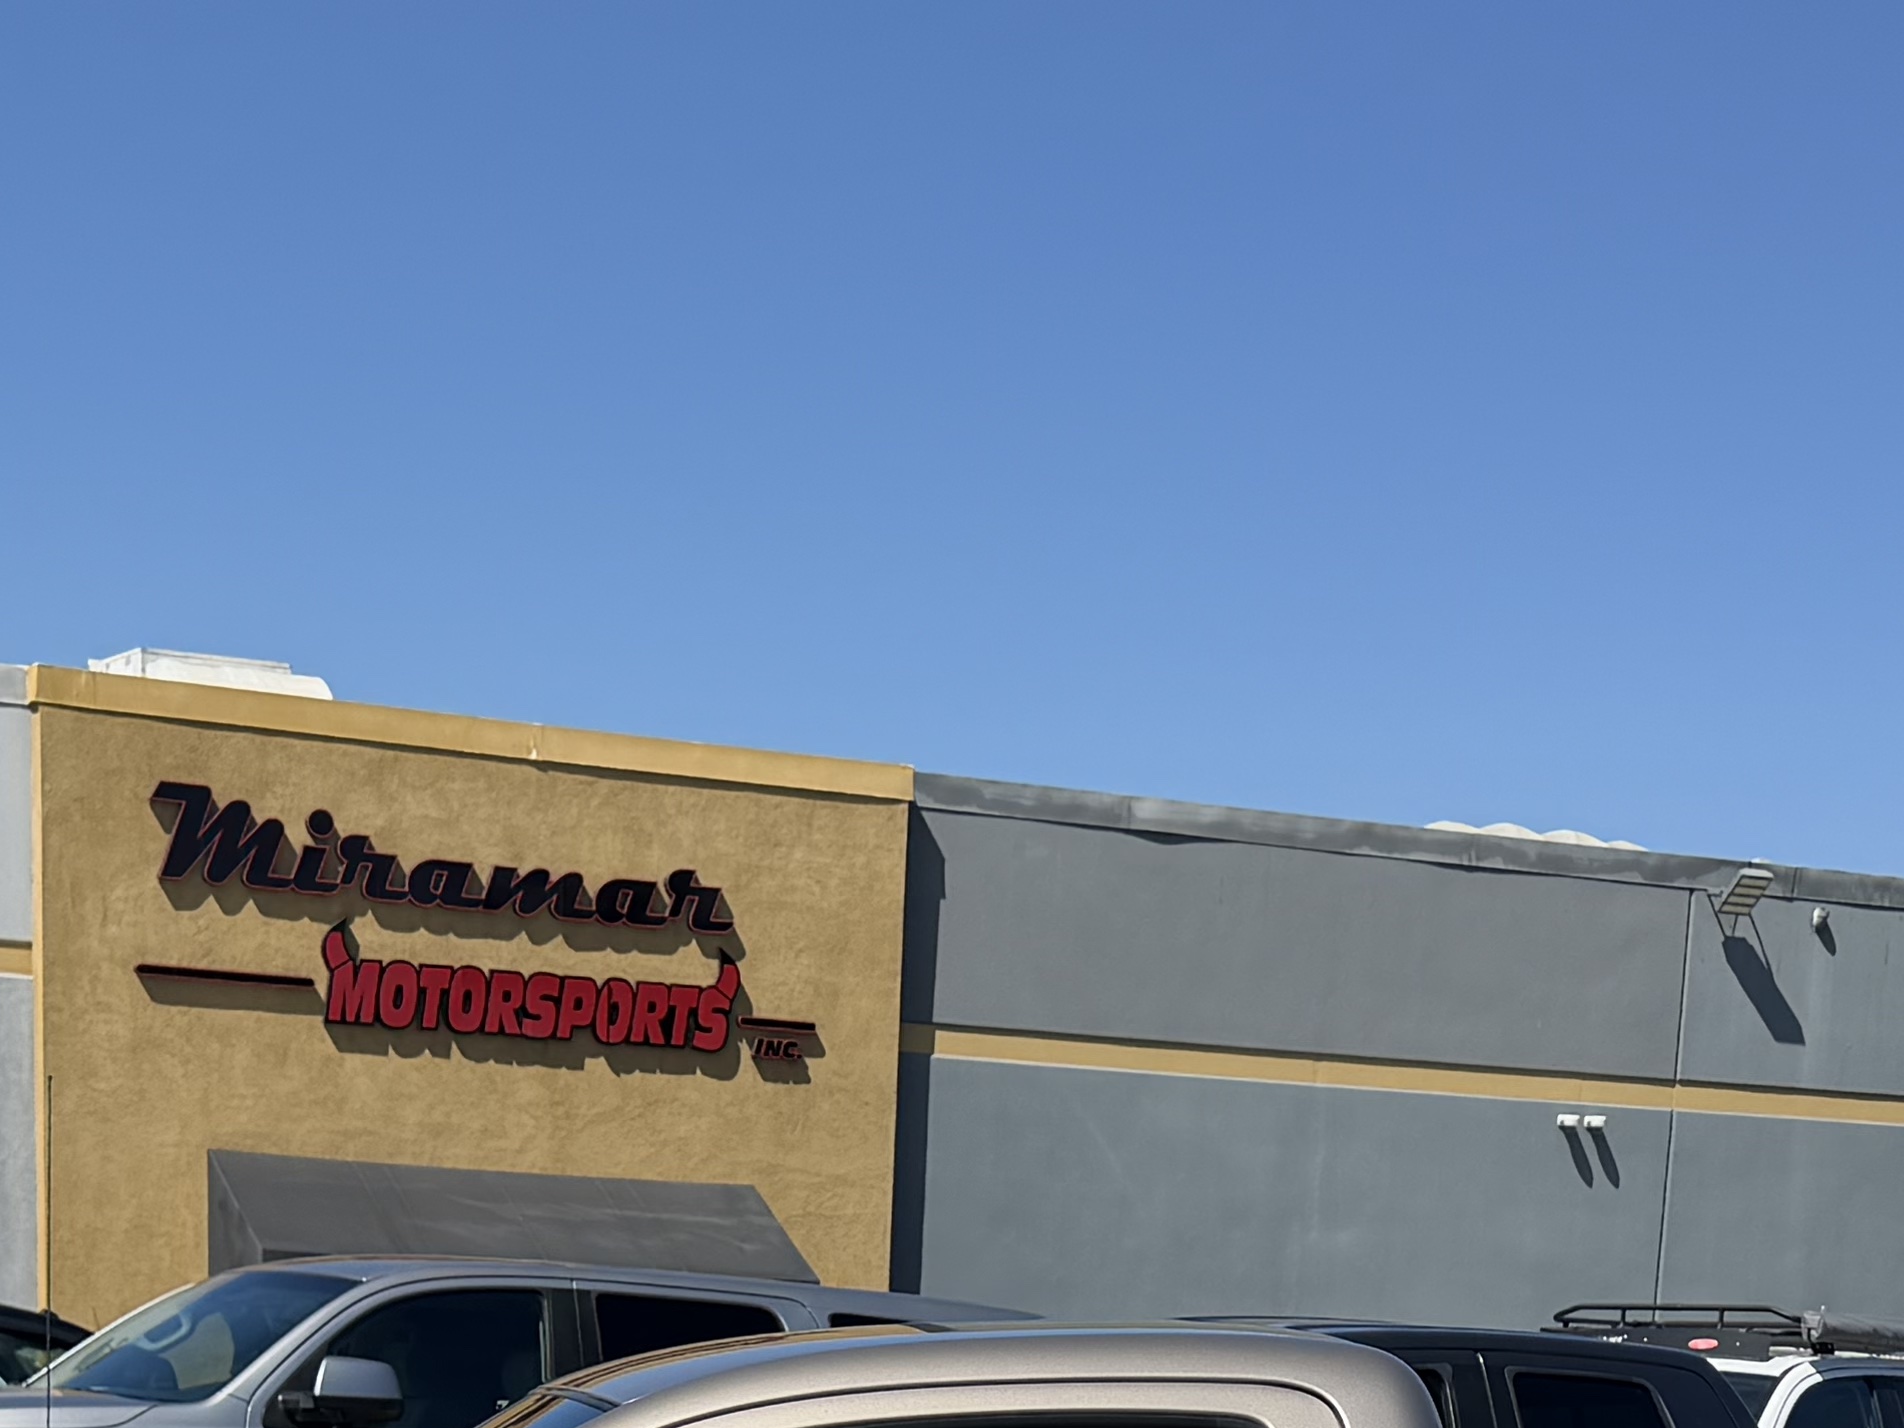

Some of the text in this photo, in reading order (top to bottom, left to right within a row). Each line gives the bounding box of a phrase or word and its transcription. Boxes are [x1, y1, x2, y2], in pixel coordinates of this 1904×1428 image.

[149, 780, 735, 932] Miramar
[324, 957, 734, 1053] MOTORSPORTS
[753, 1036, 803, 1060] INC.
